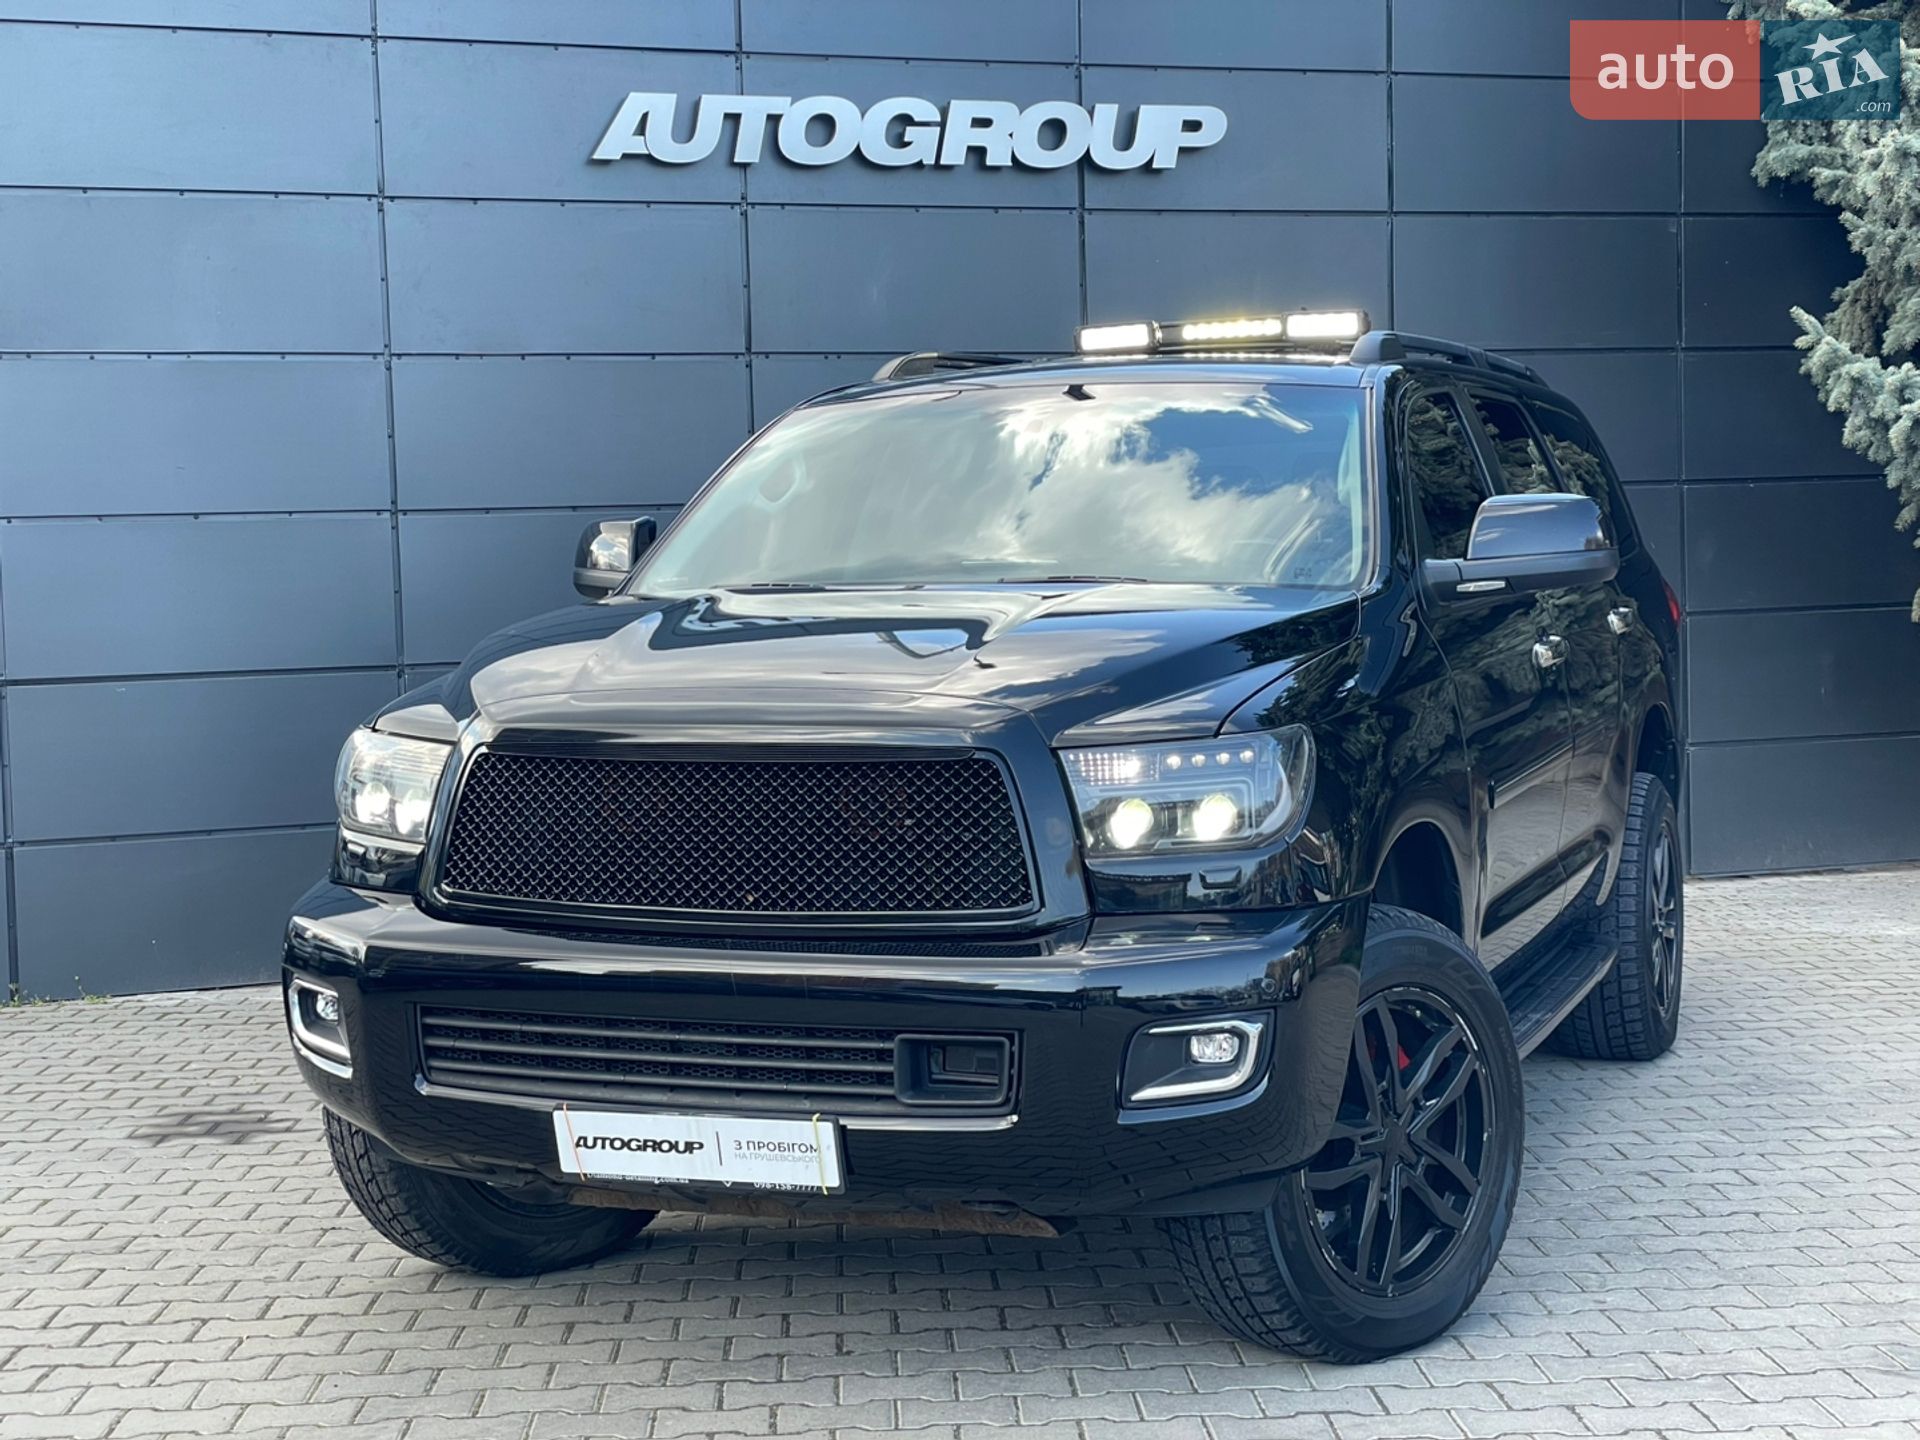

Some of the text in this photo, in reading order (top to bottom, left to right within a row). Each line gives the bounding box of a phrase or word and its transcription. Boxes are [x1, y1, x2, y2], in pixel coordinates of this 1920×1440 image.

[592, 91, 1228, 171] AUTOGROUP
[575, 1135, 704, 1155] AUTOGROUP
[746, 1140, 821, 1154] ПРОБІГОМ
[734, 1152, 748, 1160] НА
